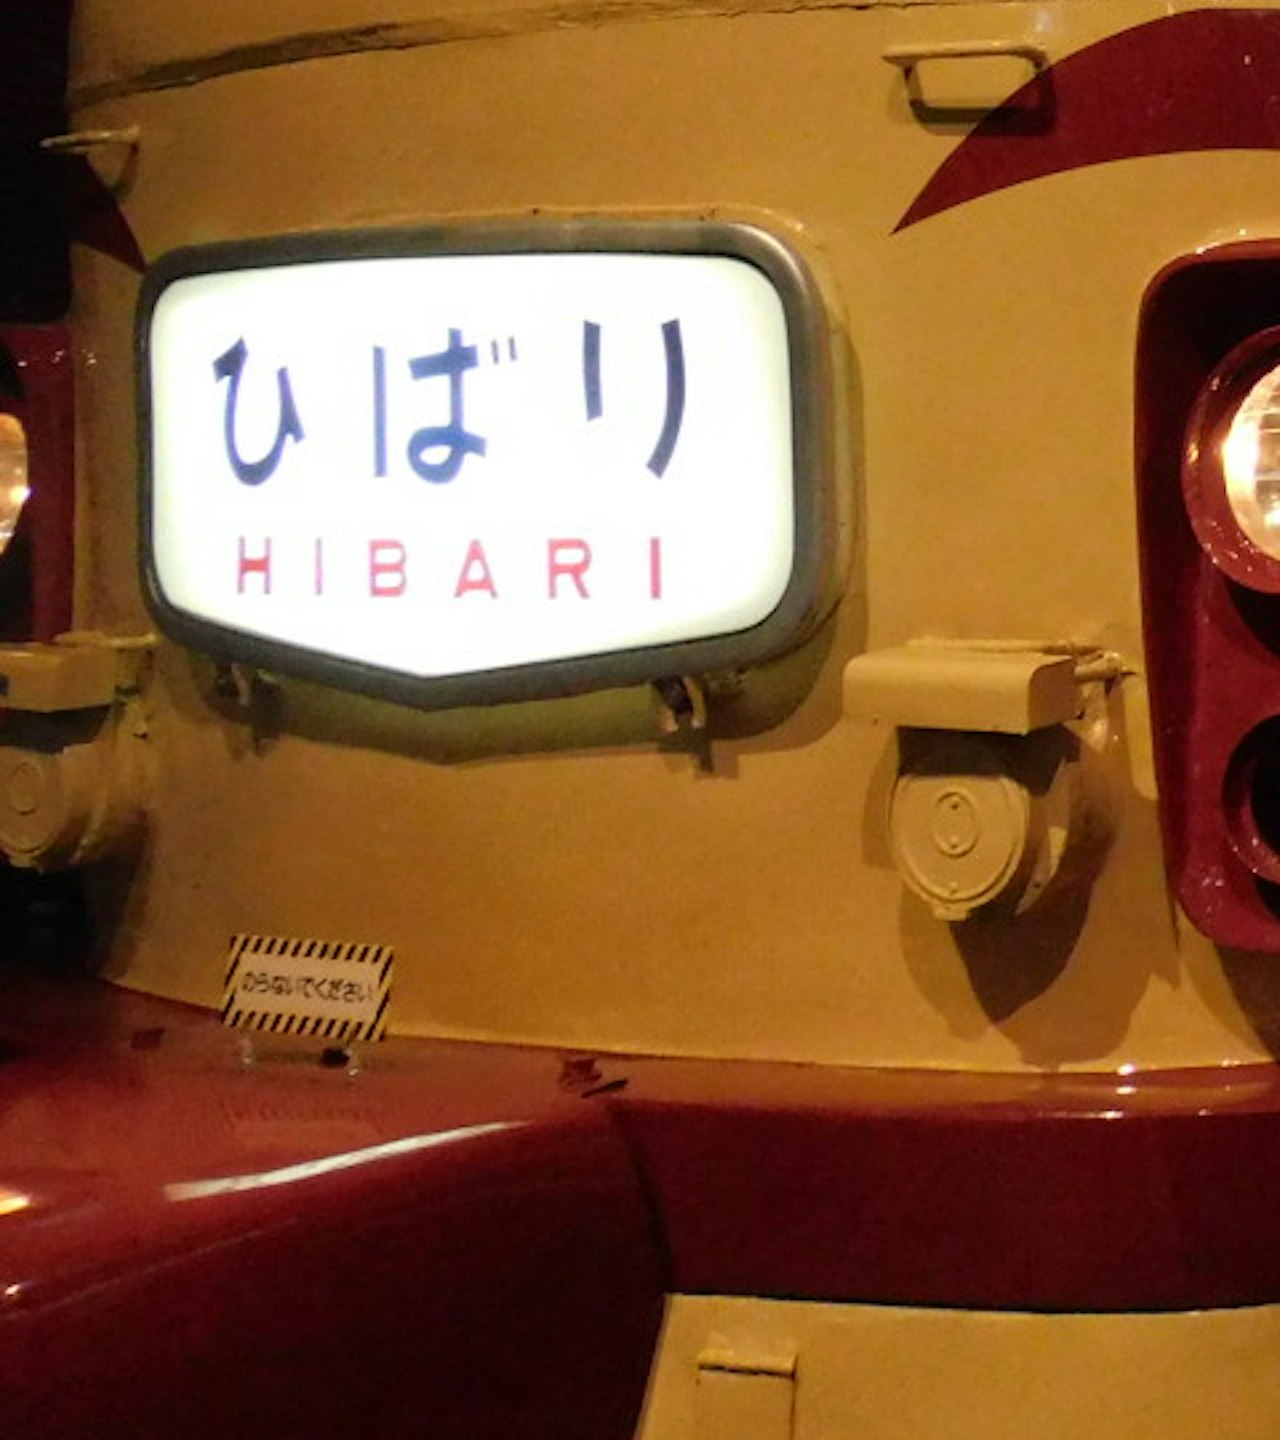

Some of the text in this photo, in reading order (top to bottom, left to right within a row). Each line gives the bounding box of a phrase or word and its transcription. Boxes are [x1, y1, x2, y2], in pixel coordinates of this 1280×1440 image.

[213, 318, 687, 487] ひばり
[237, 536, 662, 600] HIBARI
